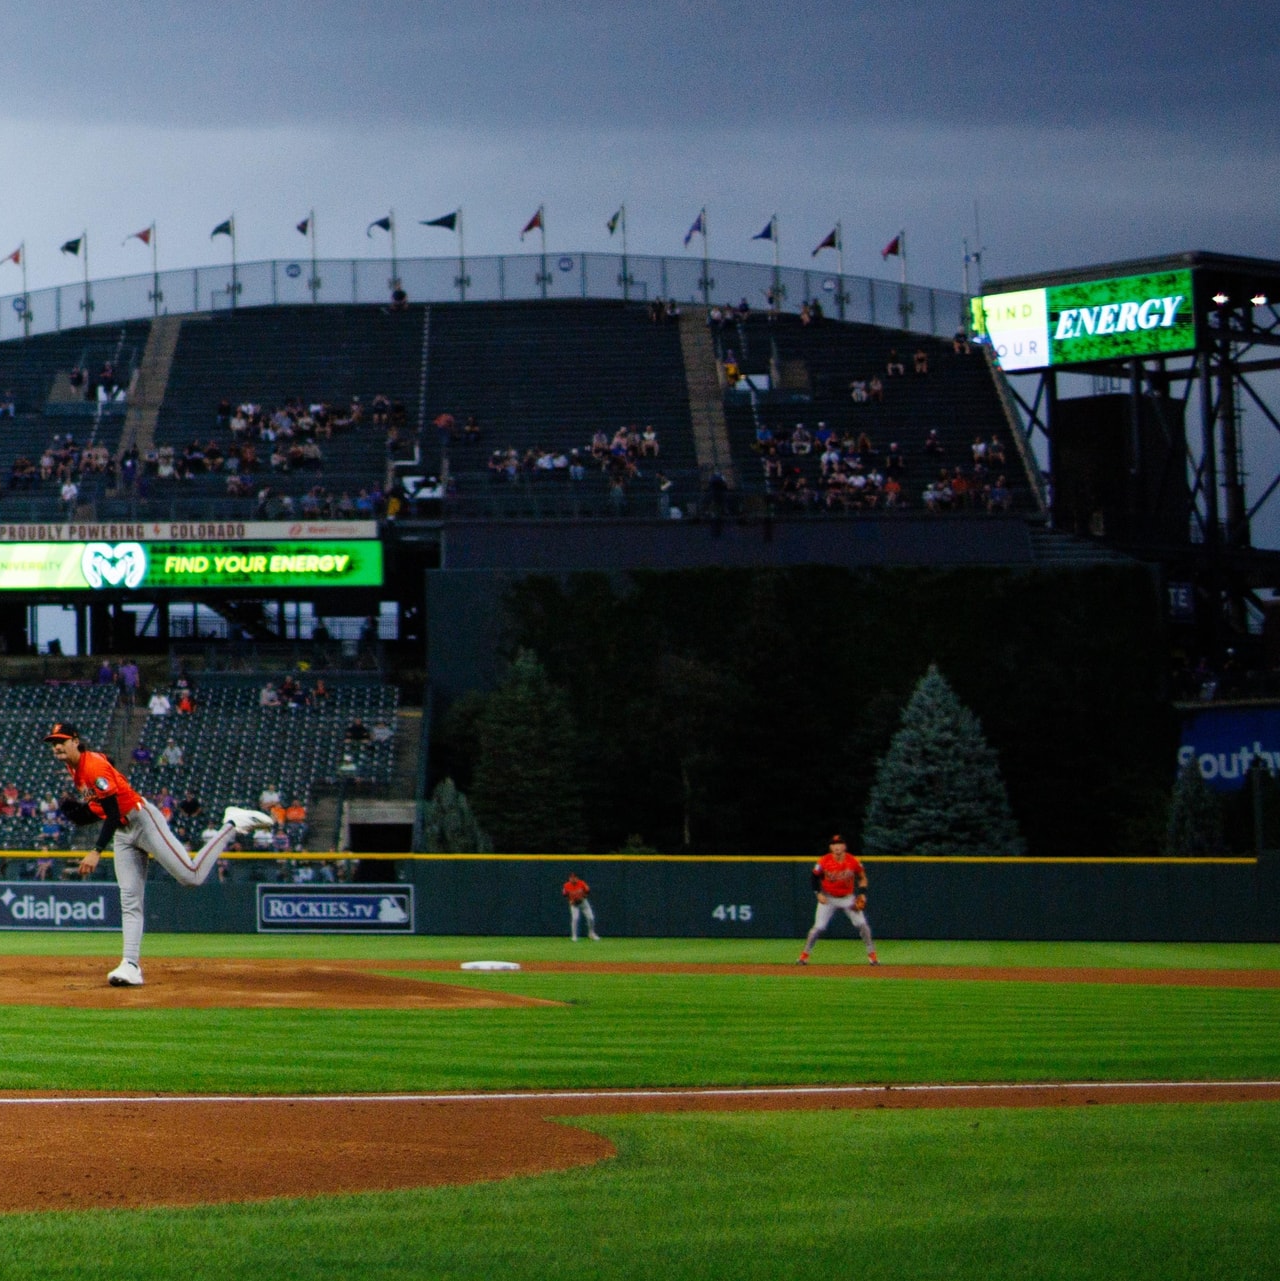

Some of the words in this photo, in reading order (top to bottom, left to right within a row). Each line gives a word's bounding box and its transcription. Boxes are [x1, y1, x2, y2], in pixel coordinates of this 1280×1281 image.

[995, 303, 1034, 321] IND
[1054, 295, 1185, 341] ENERGY
[997, 340, 1038, 358] OUR
[68, 524, 145, 540] POWERING
[170, 523, 245, 540] COLORADO
[164, 556, 209, 573] FIND
[214, 556, 267, 573] YOUR
[269, 554, 350, 572] ENERGY
[10, 896, 105, 925] dialpad
[268, 899, 374, 918] ROCKIES.TV
[712, 903, 752, 921] 415
